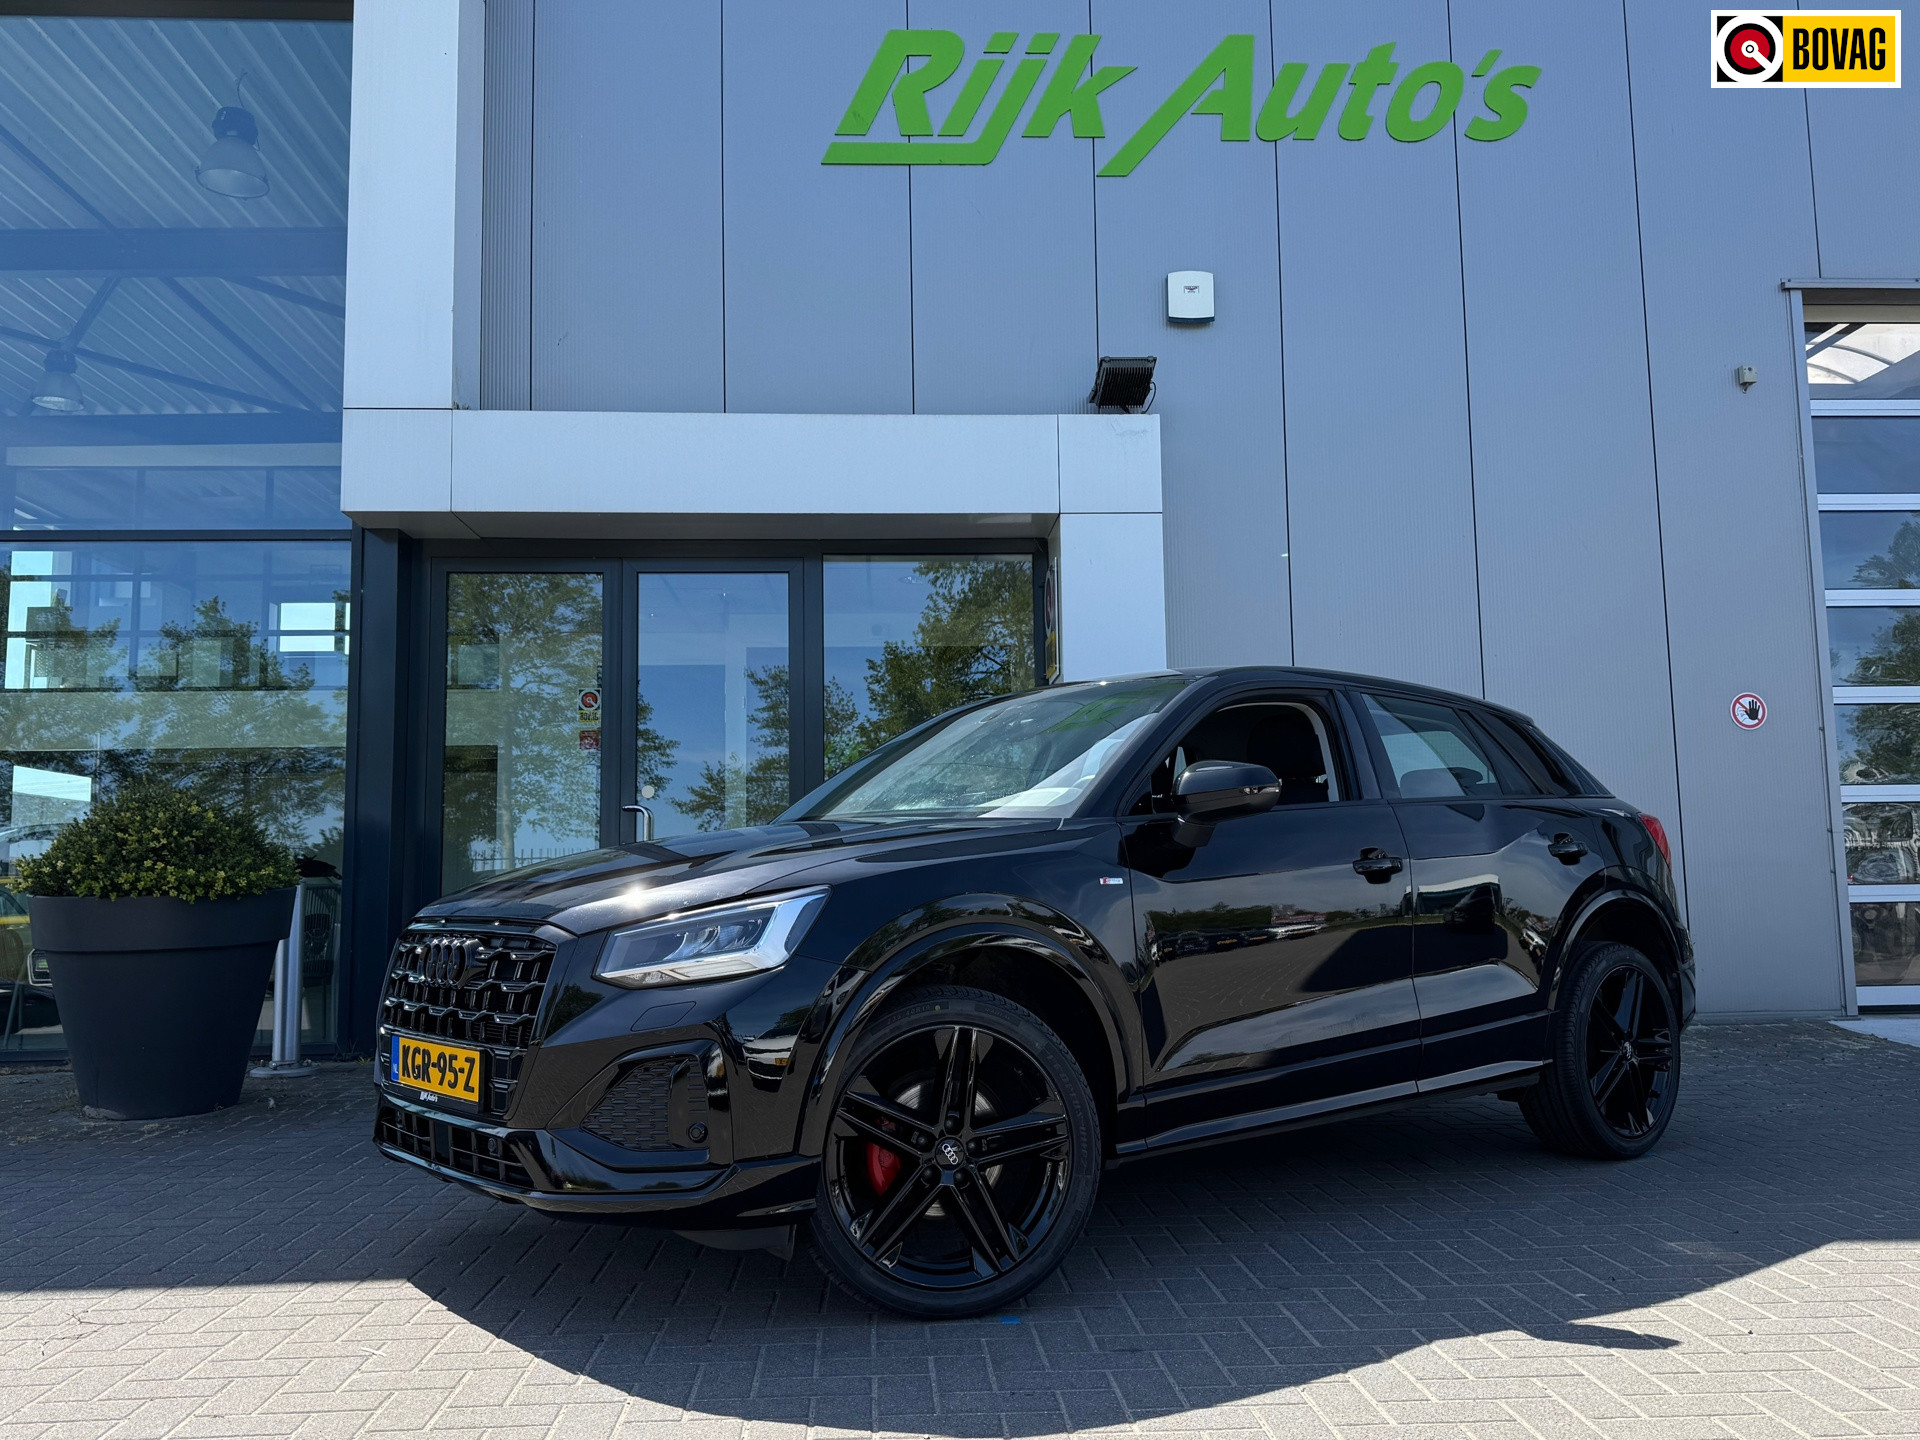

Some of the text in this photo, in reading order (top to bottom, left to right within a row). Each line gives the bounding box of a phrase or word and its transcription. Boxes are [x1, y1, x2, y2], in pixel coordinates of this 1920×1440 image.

[821, 29, 1542, 177] Rijk Auto's
[402, 1044, 475, 1093] KGR-95-Z
